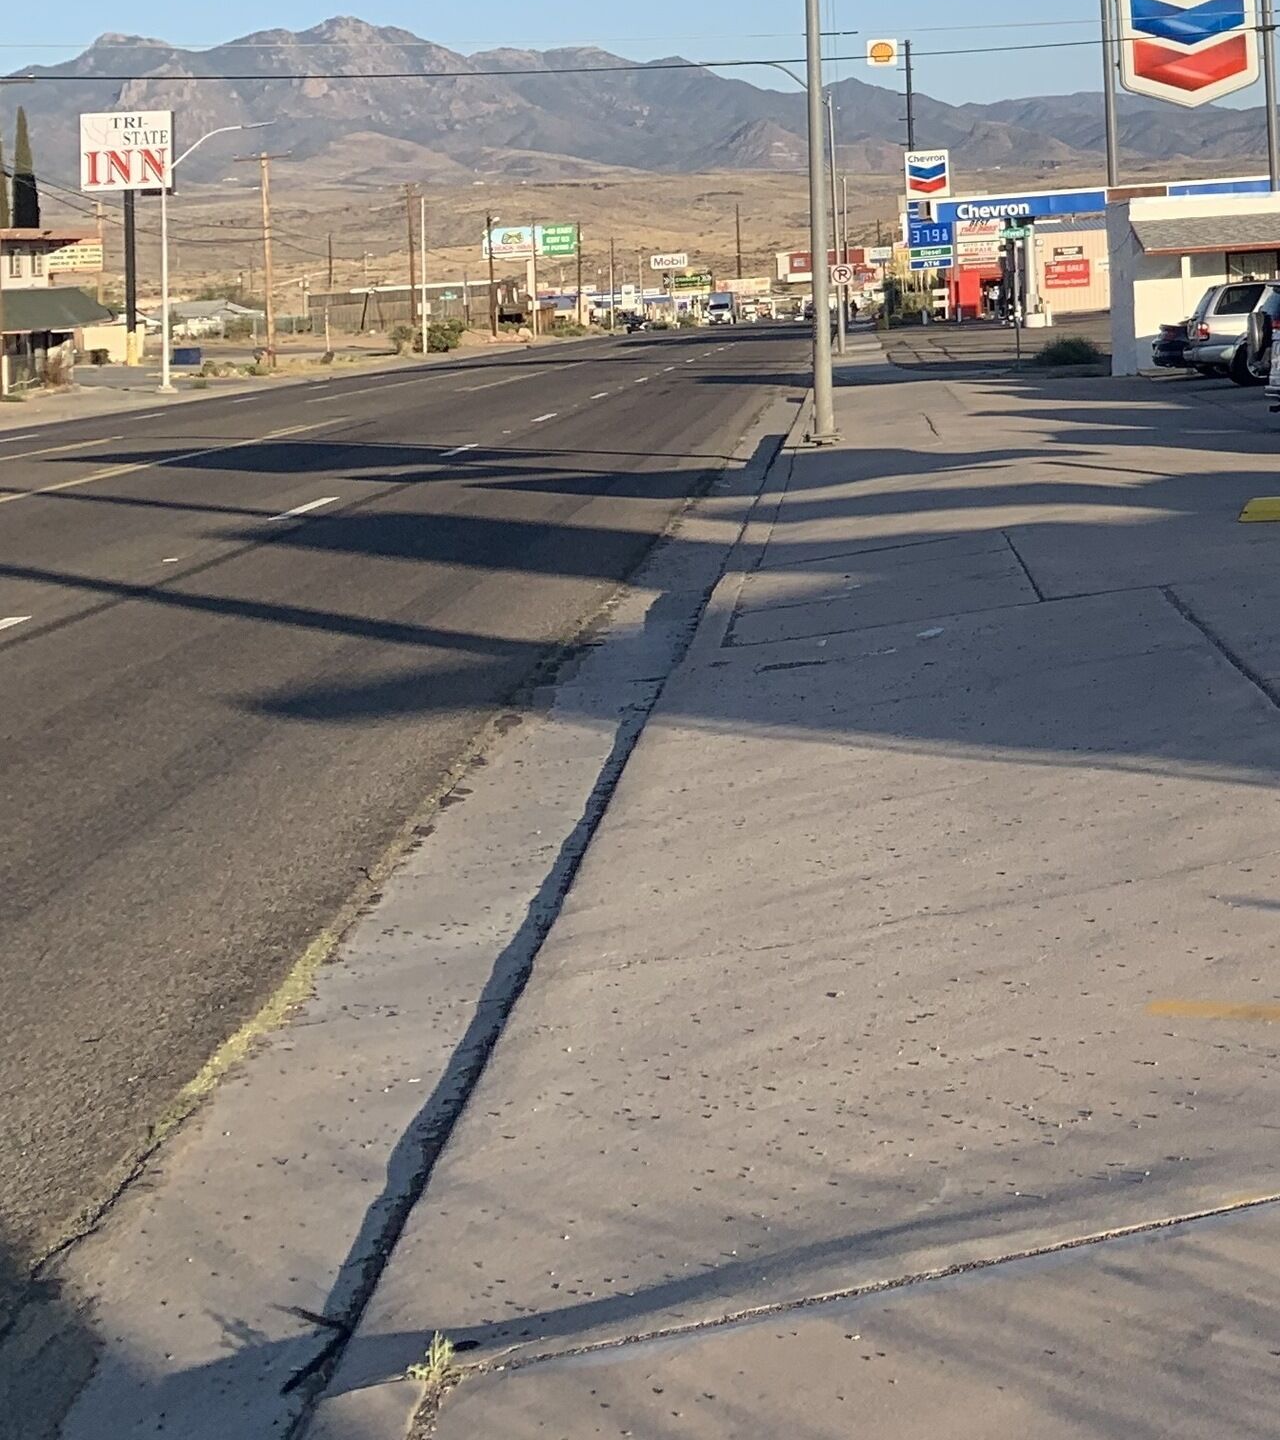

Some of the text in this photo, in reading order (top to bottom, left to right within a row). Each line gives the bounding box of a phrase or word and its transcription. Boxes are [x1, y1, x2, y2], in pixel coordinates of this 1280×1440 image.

[110, 116, 149, 129] TRI-
[122, 129, 169, 146] STATE
[907, 154, 946, 163] Chevron
[84, 147, 168, 187] INN
[956, 202, 1030, 219] Chevron
[653, 255, 685, 266] Mobil
[923, 260, 940, 268] ATM
